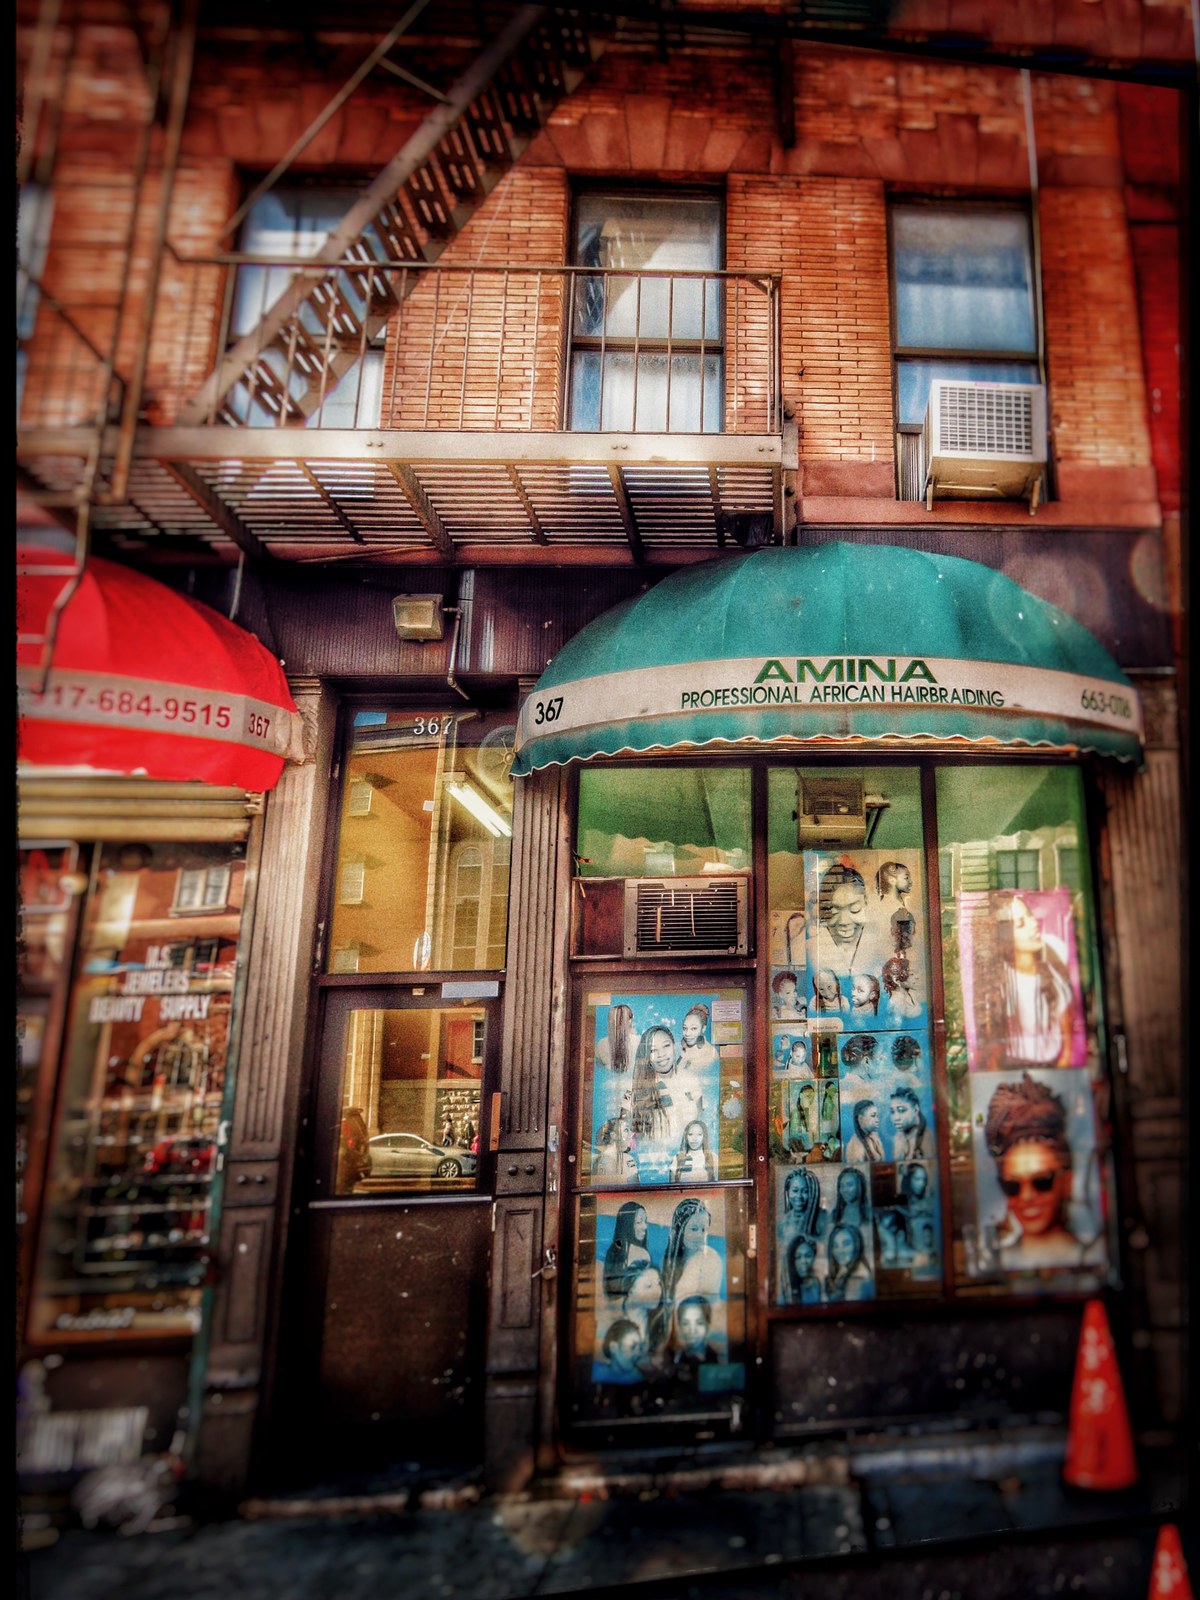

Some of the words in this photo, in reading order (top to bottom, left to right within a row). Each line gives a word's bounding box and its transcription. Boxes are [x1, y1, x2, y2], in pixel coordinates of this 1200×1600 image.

[753, 658, 938, 684] AMINA
[30, 681, 231, 730] 917-684-9515
[681, 685, 802, 710] PROFESSIONAL
[809, 684, 885, 703] AFRICAN
[891, 685, 1005, 707] HAIRBRAIDING
[535, 697, 564, 724] 367
[248, 713, 270, 738] 367
[413, 716, 454, 735] 367
[122, 970, 189, 993] JEWELERS
[90, 996, 145, 1023] BEAUTY
[160, 995, 211, 1020] SUPPLY
